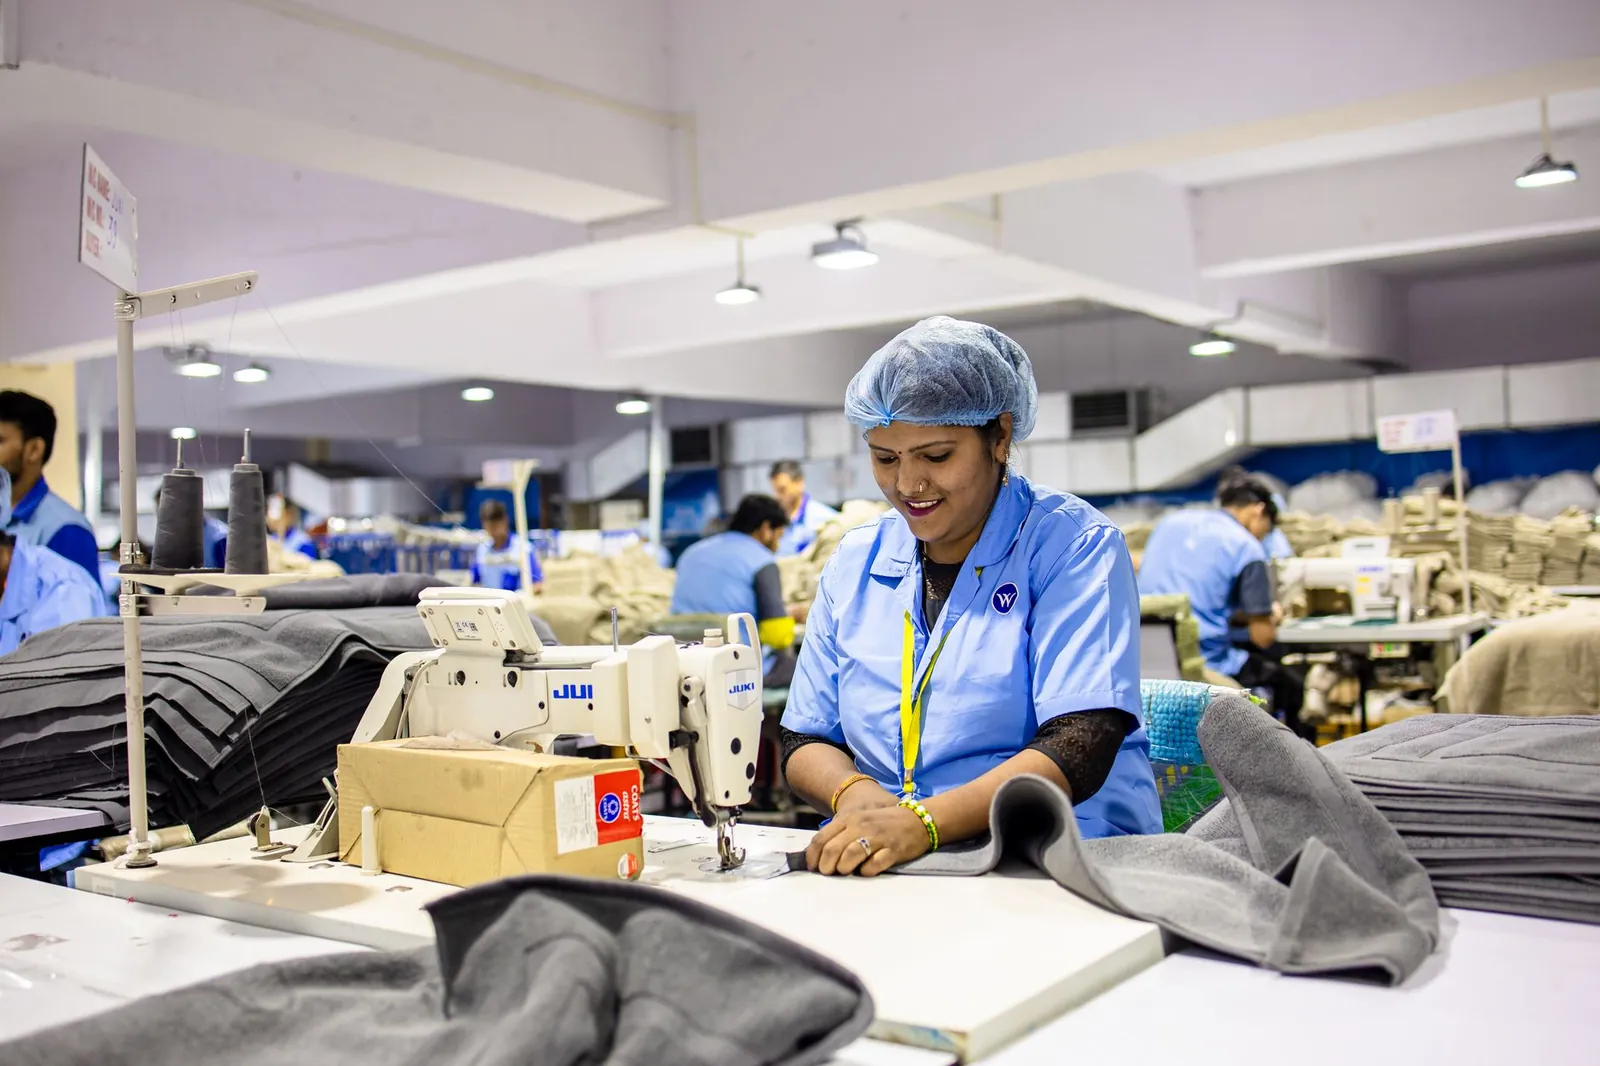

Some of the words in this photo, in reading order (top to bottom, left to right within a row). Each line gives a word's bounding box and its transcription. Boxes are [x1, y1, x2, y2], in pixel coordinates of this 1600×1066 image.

[996, 592, 1016, 608] W
[729, 682, 755, 694] JUKI
[622, 791, 630, 820] astra
[631, 784, 640, 821] COATS
